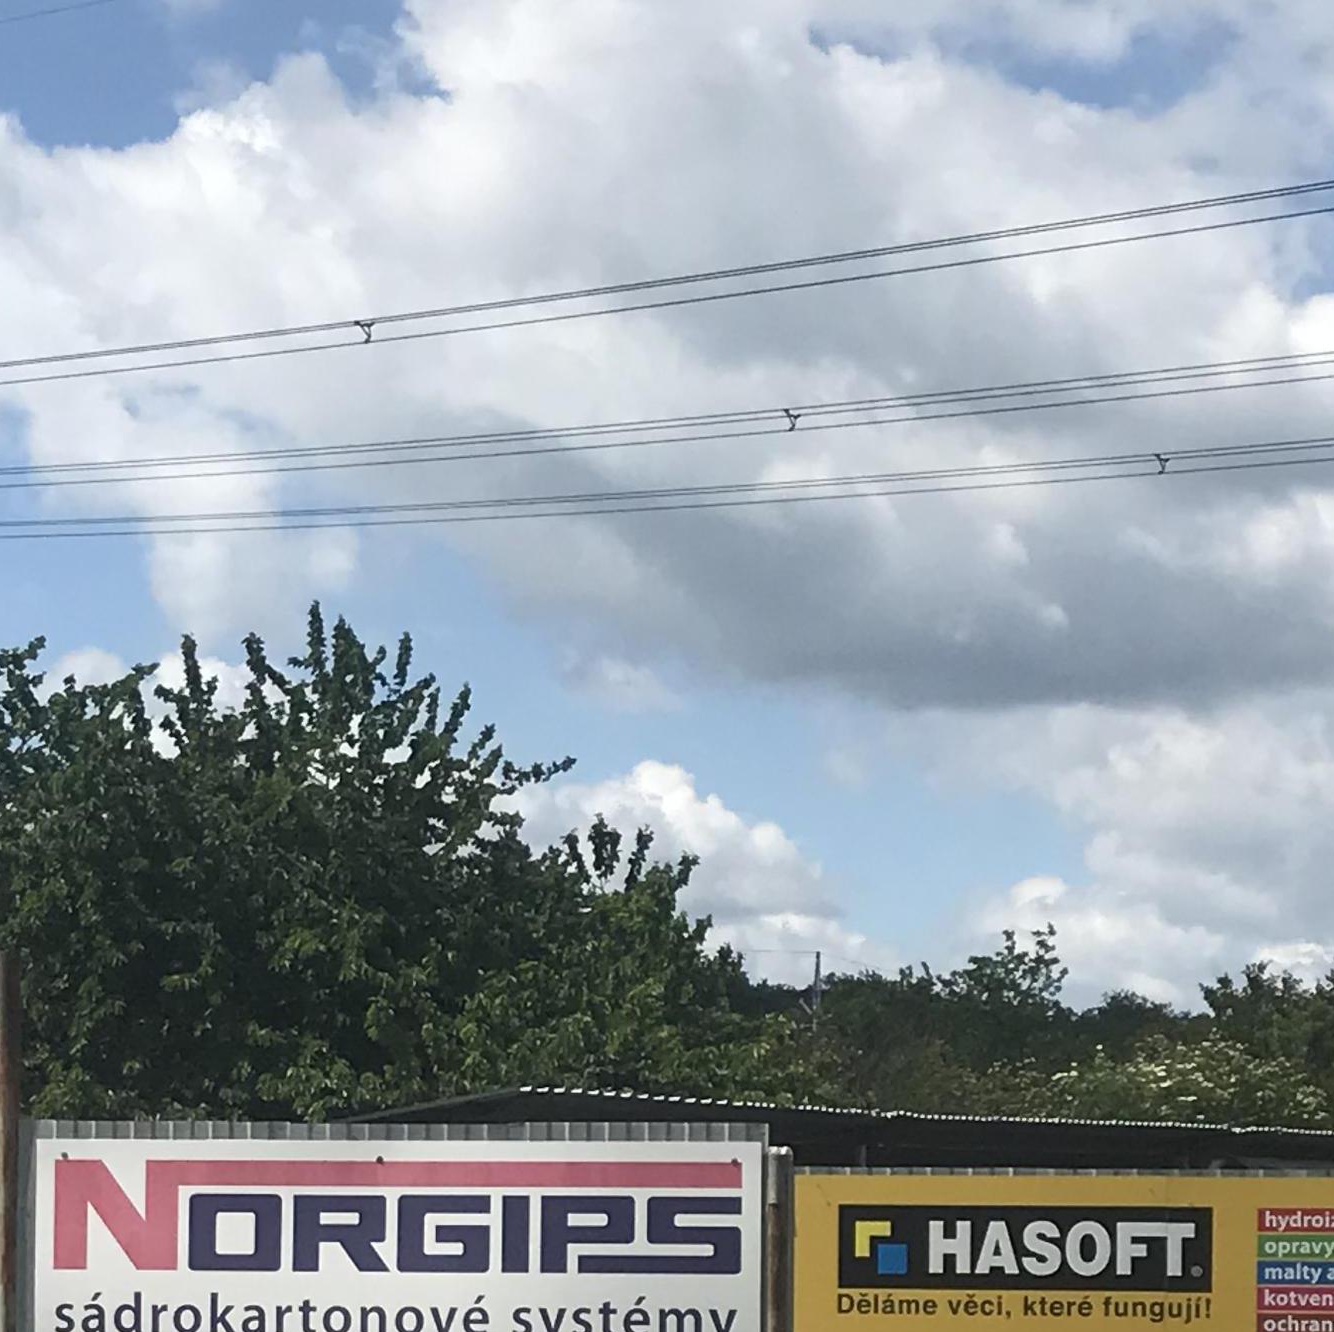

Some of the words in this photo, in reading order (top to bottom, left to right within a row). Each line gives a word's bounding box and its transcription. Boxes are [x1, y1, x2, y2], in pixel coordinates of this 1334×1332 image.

[53, 1158, 743, 1275] NORGIPS
[927, 1219, 1197, 1278] HASOFT
[1263, 1264, 1322, 1285] malty
[836, 1292, 939, 1317] Děláme
[947, 1293, 1013, 1320] věci,
[1022, 1295, 1094, 1319] které
[1103, 1297, 1213, 1326] fungují!
